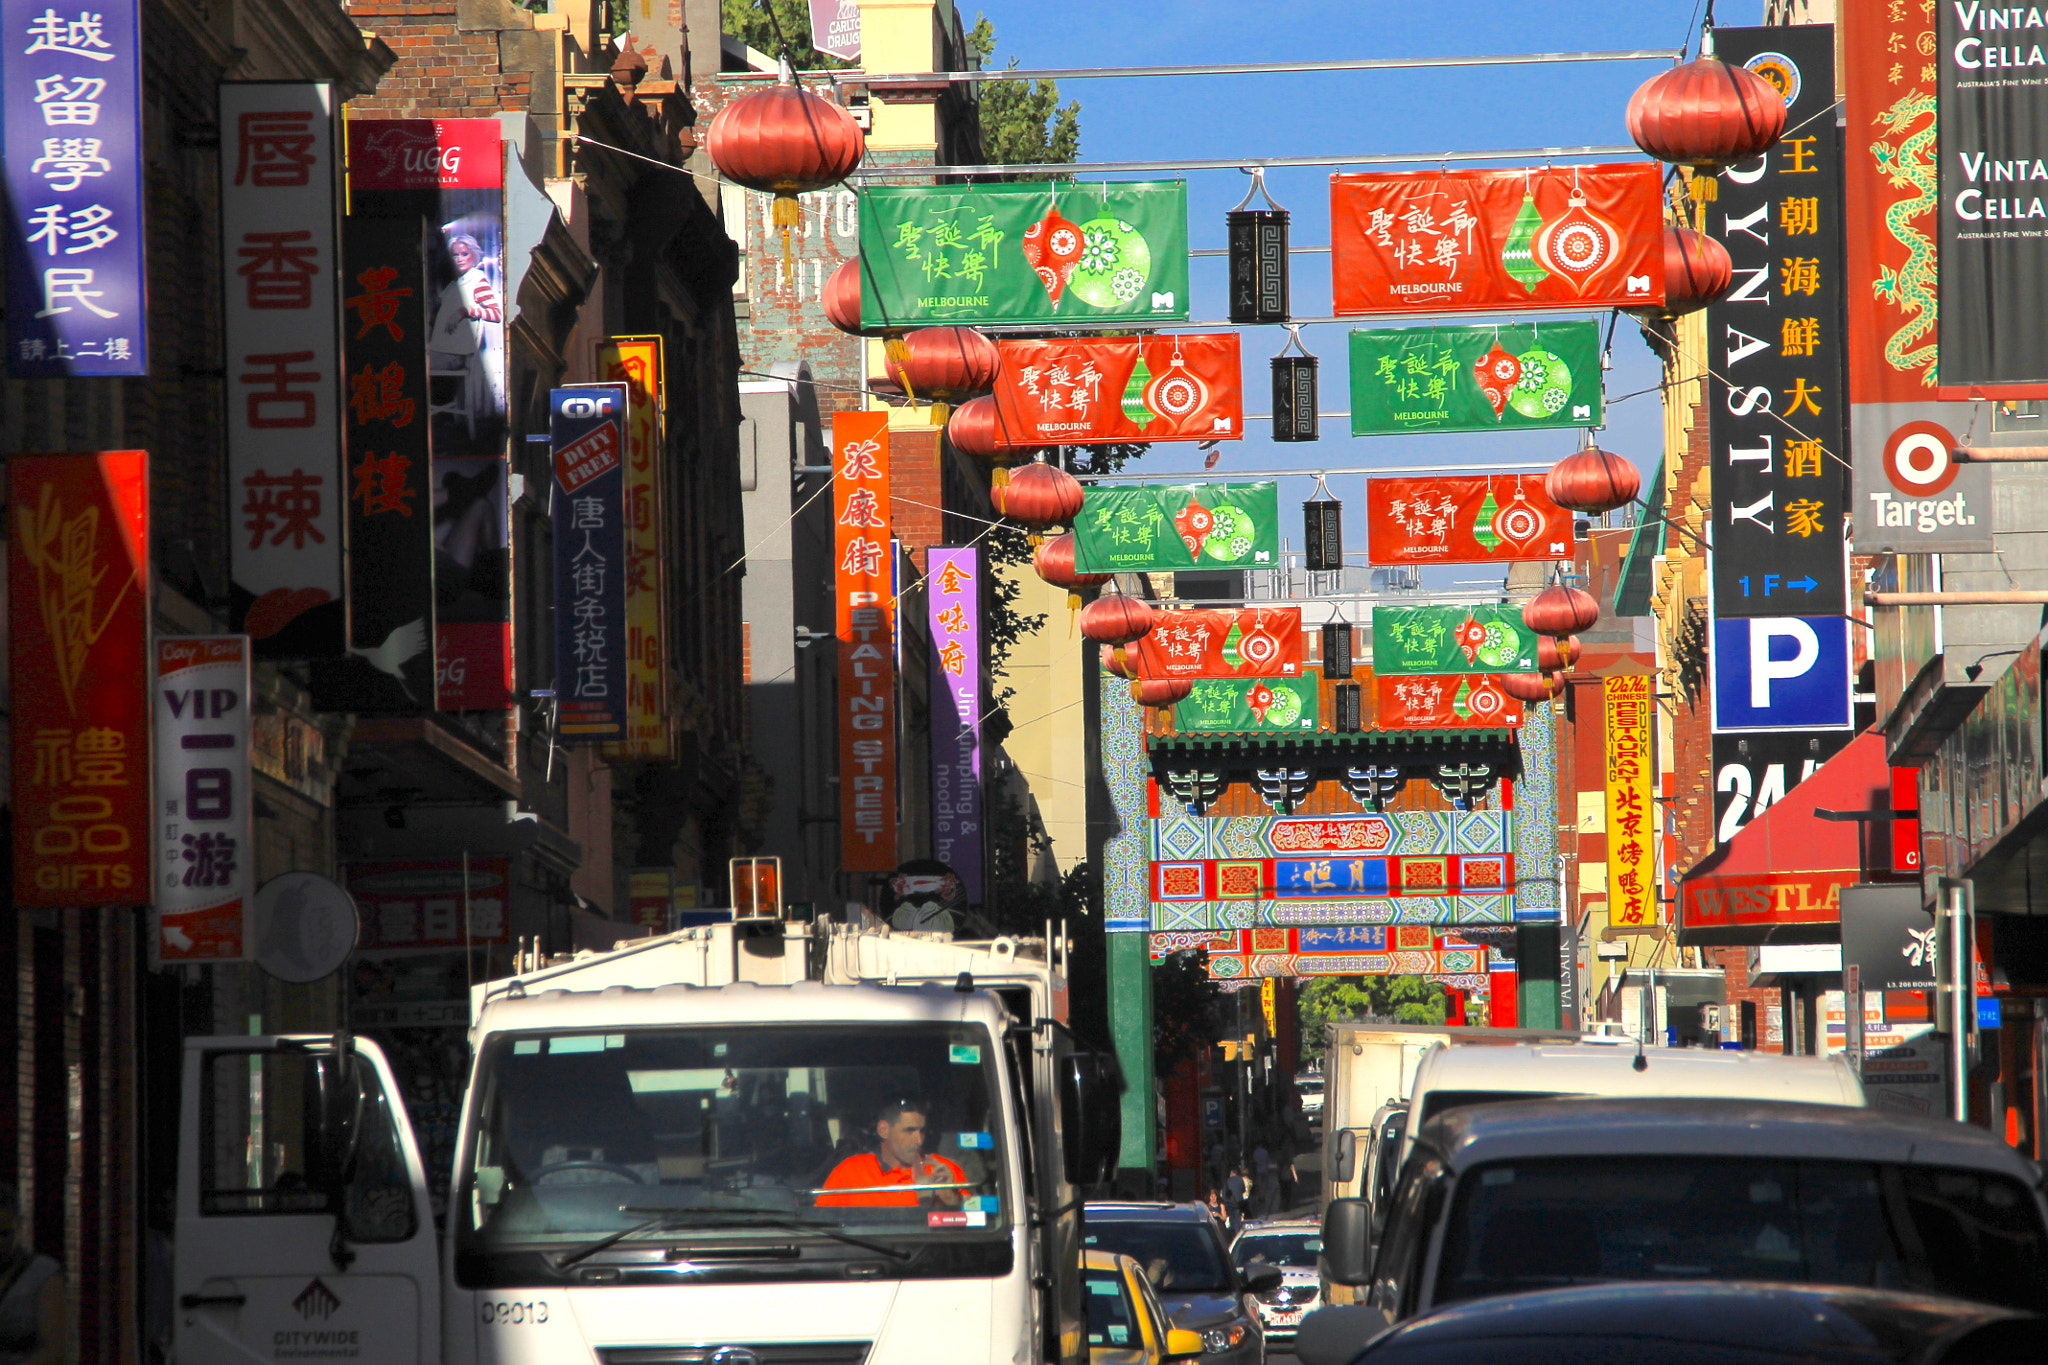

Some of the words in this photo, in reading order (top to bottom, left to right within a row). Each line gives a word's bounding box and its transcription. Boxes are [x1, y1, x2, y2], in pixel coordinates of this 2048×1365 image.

[1954, 0, 2048, 31] VINTA
[828, 31, 860, 49] DRAUG
[24, 8, 119, 319] 越留學移民
[403, 145, 462, 174] UGG
[892, 214, 1006, 269] 聖誕節
[1364, 200, 1478, 255] 聖誕節
[921, 248, 988, 294] 快樂
[1393, 234, 1462, 280] 快樂
[917, 295, 989, 308] MELBOURNE
[1389, 282, 1463, 295] MELBOURNE
[233, 110, 322, 550] 唇香舌辣
[1778, 135, 1824, 537] 王朝海鮮大酒家
[19, 336, 133, 361] 請上二樓
[1017, 360, 1103, 402] 聖誕節
[1374, 349, 1461, 391] 聖誕節
[345, 266, 416, 517] 黃鶴樓
[1039, 386, 1092, 421] 快樂
[1397, 373, 1448, 410] 快樂
[1036, 421, 1092, 432] MELBOURNE
[1394, 410, 1449, 421] MELBOURNE
[563, 428, 613, 467] DUTY
[566, 450, 615, 488] FREE
[838, 440, 885, 577] 茨廠街
[1094, 503, 1165, 538] 聖誕節
[1388, 495, 1458, 529] 聖誕節
[1112, 527, 1154, 552] 快樂
[1405, 516, 1448, 545] 快樂
[1109, 553, 1155, 561] MELBOURNE
[1403, 545, 1449, 553] MELBOURNE
[936, 560, 972, 676] 金味府
[849, 591, 885, 730] PETALING
[1166, 663, 1203, 671] MELBOURNE
[1402, 659, 1438, 667] MELBOURNE
[1750, 617, 1819, 708] P
[957, 686, 974, 716] Jin
[1606, 675, 1630, 693] Da
[1629, 676, 1648, 693] Hu
[1606, 693, 1648, 702] CHINESE
[163, 689, 238, 719] VIP
[1607, 702, 1617, 783] PEKING
[1616, 701, 1639, 784] RESTAURANT
[1638, 702, 1648, 757] DUCK
[956, 722, 978, 813] dumpling
[852, 739, 884, 844] STREET
[936, 763, 955, 831] noodle
[960, 820, 977, 836] &
[1616, 786, 1644, 923] 北京烤鴨店
[35, 863, 133, 890] GIFTS
[482, 1301, 549, 1325] 09013
[273, 1331, 359, 1345] CITYWIDE
